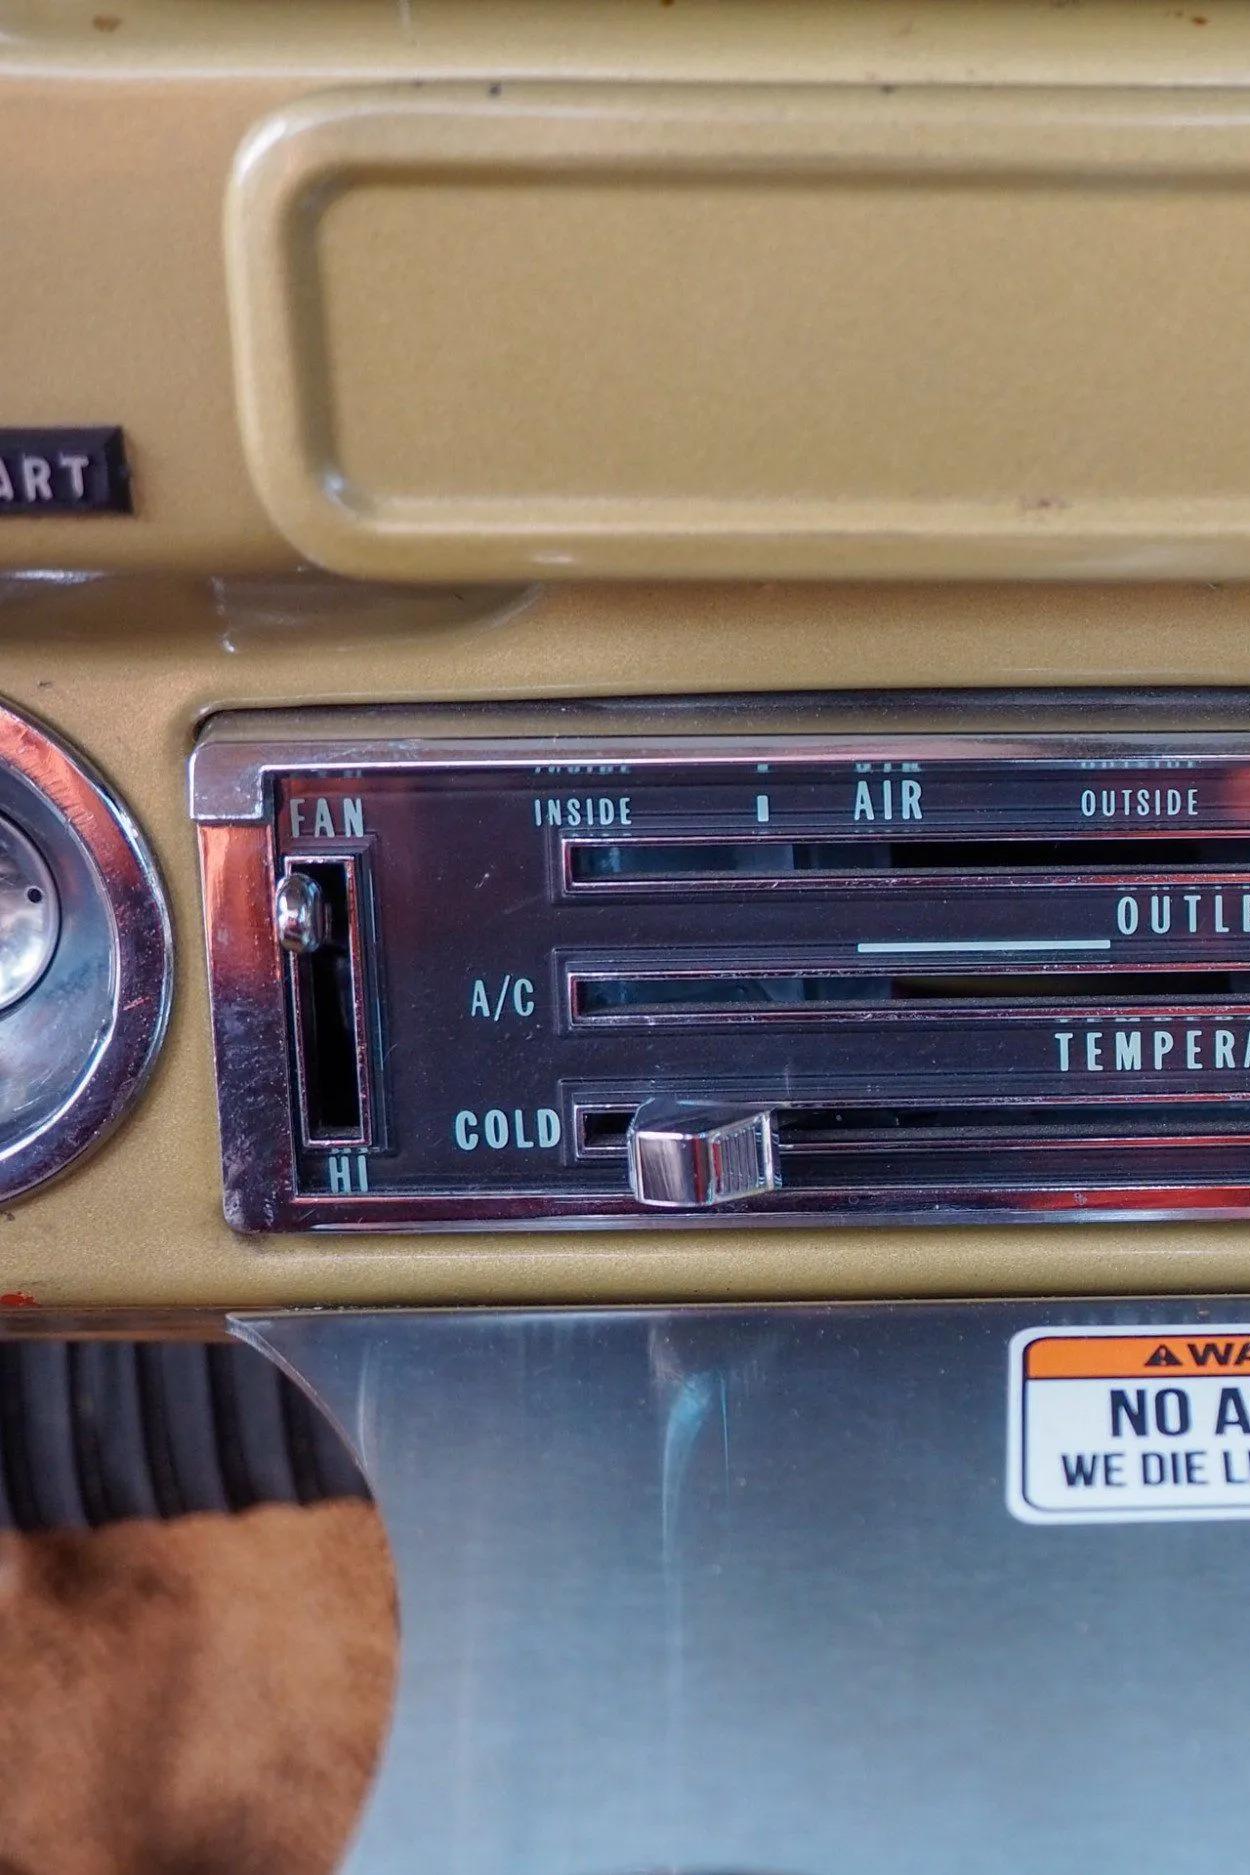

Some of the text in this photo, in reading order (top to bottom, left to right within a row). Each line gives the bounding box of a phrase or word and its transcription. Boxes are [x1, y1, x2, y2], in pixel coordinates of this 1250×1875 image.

[290, 798, 365, 837] FAN
[534, 797, 633, 826] INSIDE
[853, 779, 923, 821] AIR
[1081, 788, 1199, 817] OUTSIDE
[470, 974, 535, 1021] A/C
[455, 1107, 562, 1150] COLD
[328, 1155, 368, 1193] HI
[1110, 1387, 1190, 1438] NO
[1061, 1453, 1126, 1488] WE
[1142, 1451, 1202, 1486] DIE
